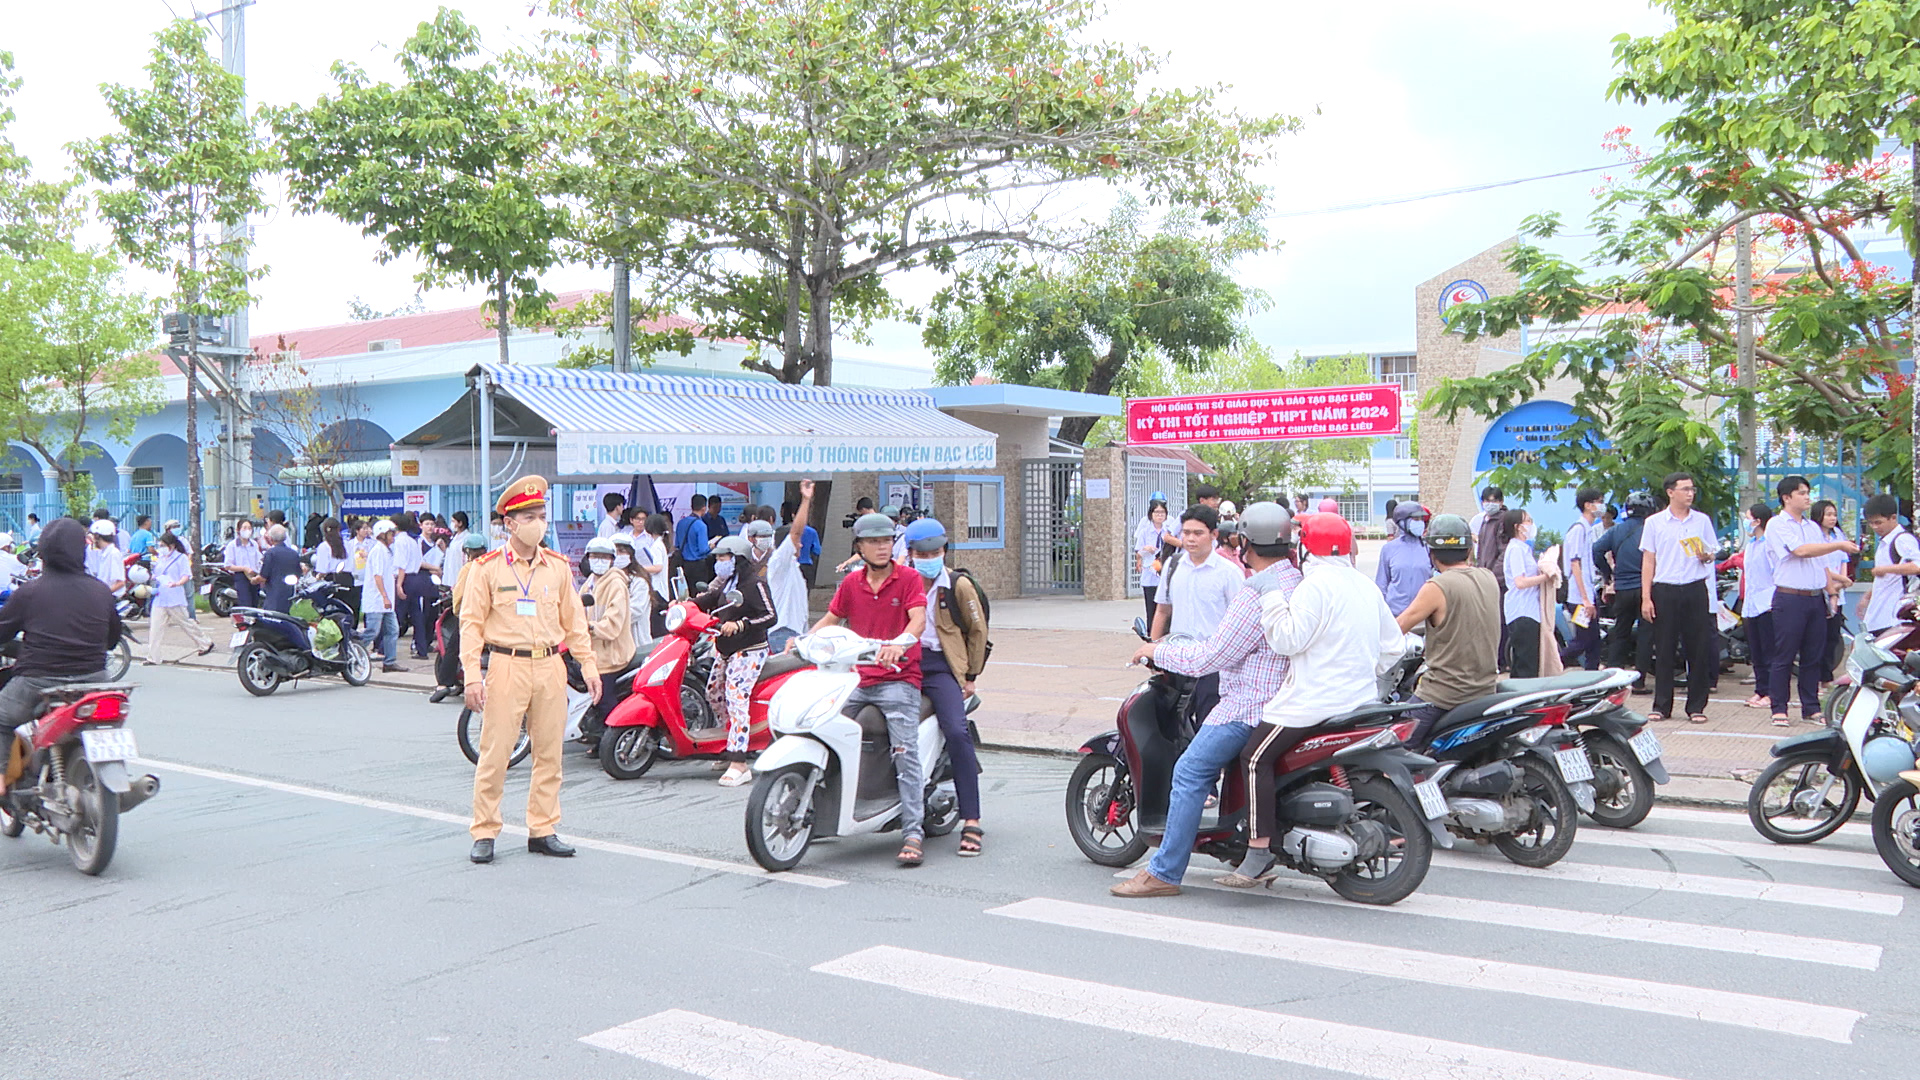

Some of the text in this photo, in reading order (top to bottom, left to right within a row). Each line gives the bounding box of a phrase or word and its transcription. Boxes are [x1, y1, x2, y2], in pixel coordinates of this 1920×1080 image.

[1151, 404, 1166, 413] HỘI
[1168, 402, 1193, 411] ĐỒNG
[1195, 402, 1209, 410] THI
[1211, 399, 1225, 409] SỞ
[1226, 399, 1248, 408] GIÁO
[1271, 396, 1284, 406] VÀ
[1307, 395, 1326, 405] TẠO
[1328, 394, 1348, 404] BẠC
[1350, 392, 1373, 401] LIÊU
[1136, 406, 1389, 429] KỲ THI TỐT NGHIỆP THPT NĂM 2024
[1178, 431, 1192, 439] THI
[1195, 429, 1208, 438] SỐ
[1209, 429, 1220, 437] 01
[1223, 427, 1260, 437] TRƯỜNG
[1262, 426, 1286, 435] THPT
[1287, 423, 1326, 433] CHUYÊN
[1328, 423, 1348, 433] BẠC
[1350, 421, 1373, 431] LIÊU
[587, 440, 668, 465] TRƯỜNG
[674, 444, 736, 465] TRUNG
[741, 446, 775, 468] HỌC
[781, 439, 815, 464] PHỔ
[818, 443, 868, 464] THÔNG
[873, 443, 930, 463] CHUYÊN
[934, 446, 962, 466] BẠC
[965, 443, 993, 462] LIÊU
